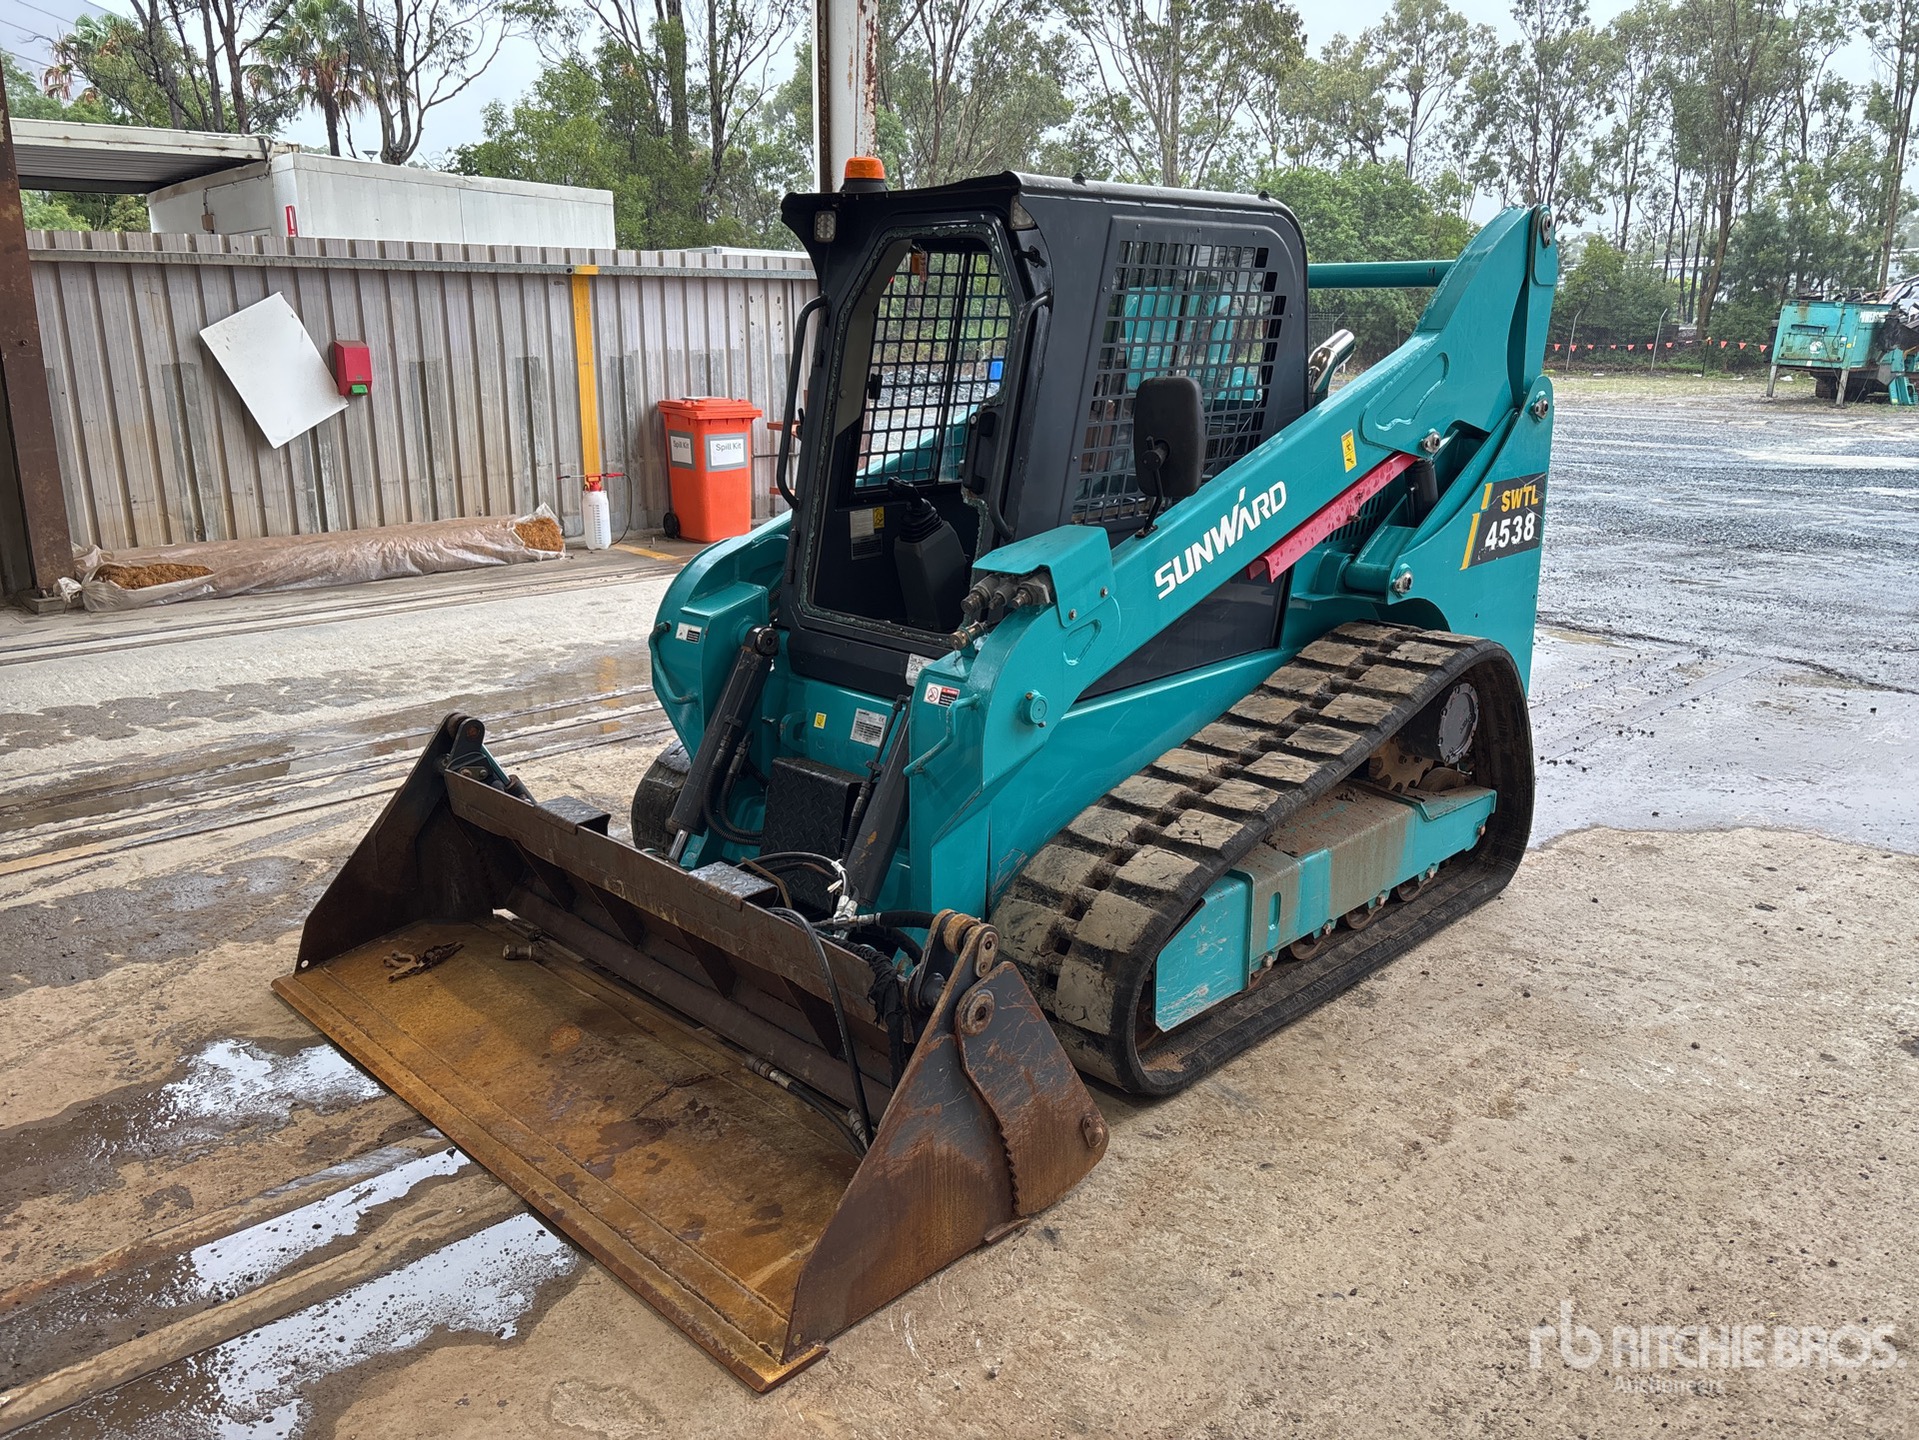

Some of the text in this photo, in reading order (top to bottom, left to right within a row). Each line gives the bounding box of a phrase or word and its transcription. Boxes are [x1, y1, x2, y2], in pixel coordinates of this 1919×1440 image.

[673, 440, 682, 449] Spill
[715, 442, 742, 452] Spill Kit
[1501, 484, 1539, 513] SWTL
[1154, 480, 1287, 601] SUNWARD
[1484, 512, 1536, 551] 4538
